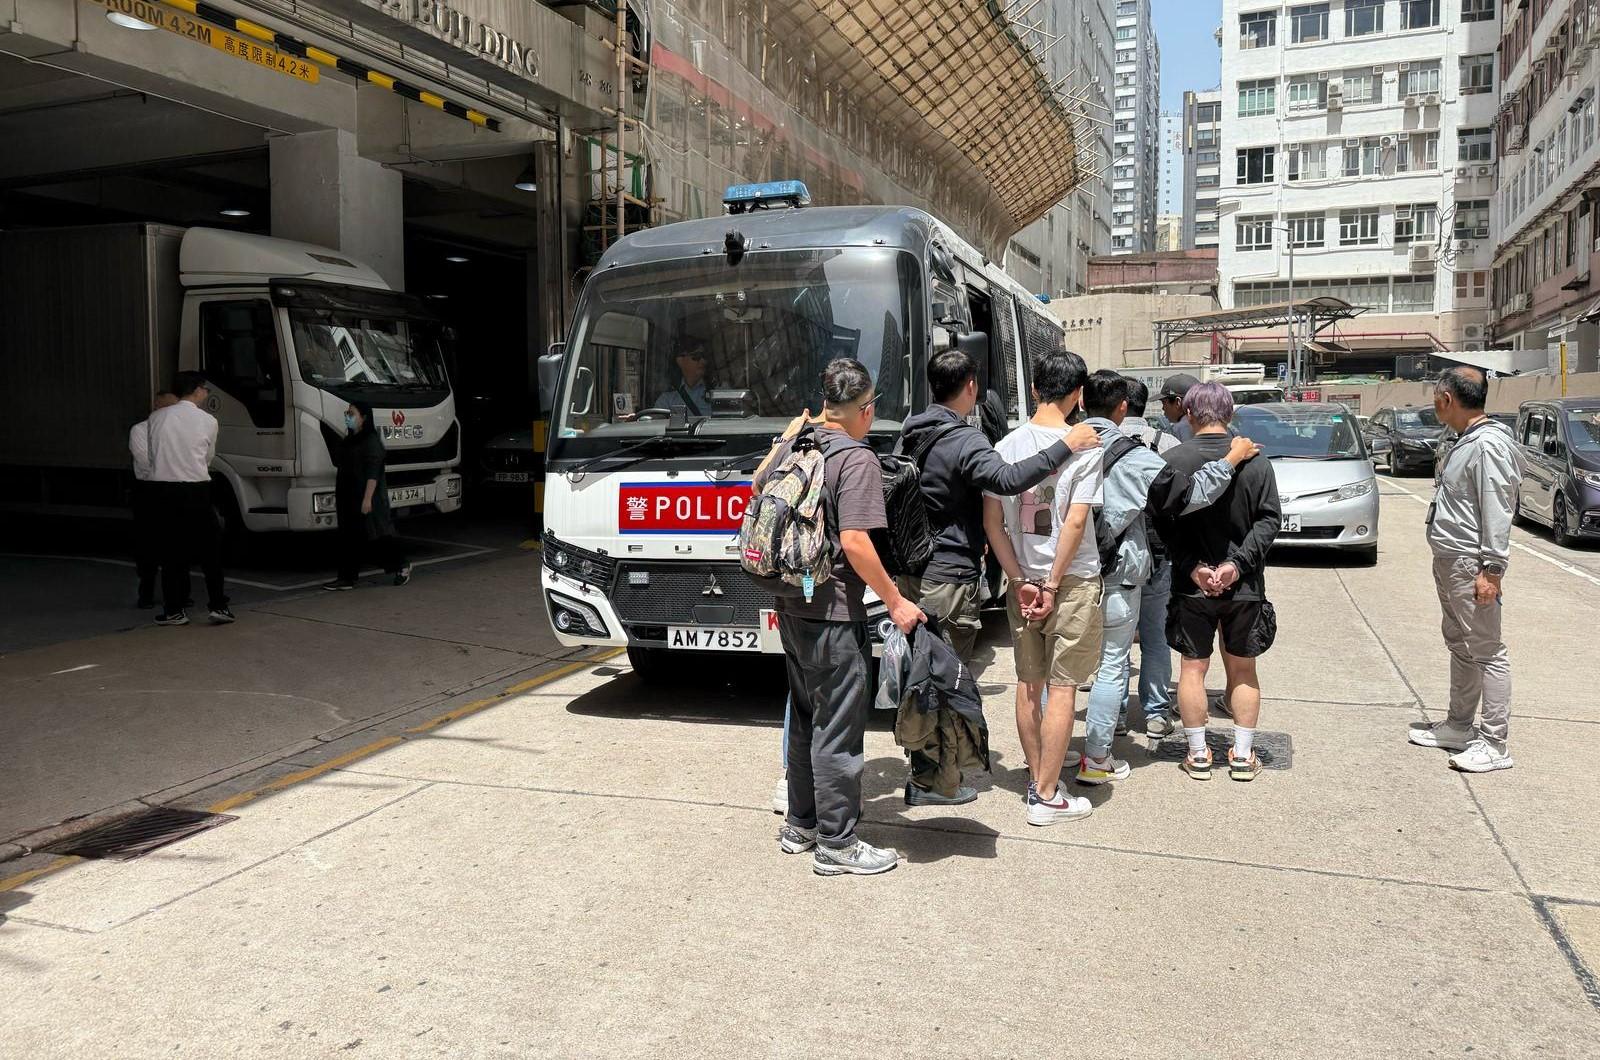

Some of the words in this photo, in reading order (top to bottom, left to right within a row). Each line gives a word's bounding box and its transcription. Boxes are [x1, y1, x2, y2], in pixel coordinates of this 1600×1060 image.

[171, 15, 211, 44] 4.2M
[413, 0, 540, 78] BUILDING
[405, 488, 419, 500] 374
[626, 496, 649, 520] 警
[655, 495, 745, 520] POLIC
[673, 629, 698, 647] AM
[703, 630, 758, 648] 7852
